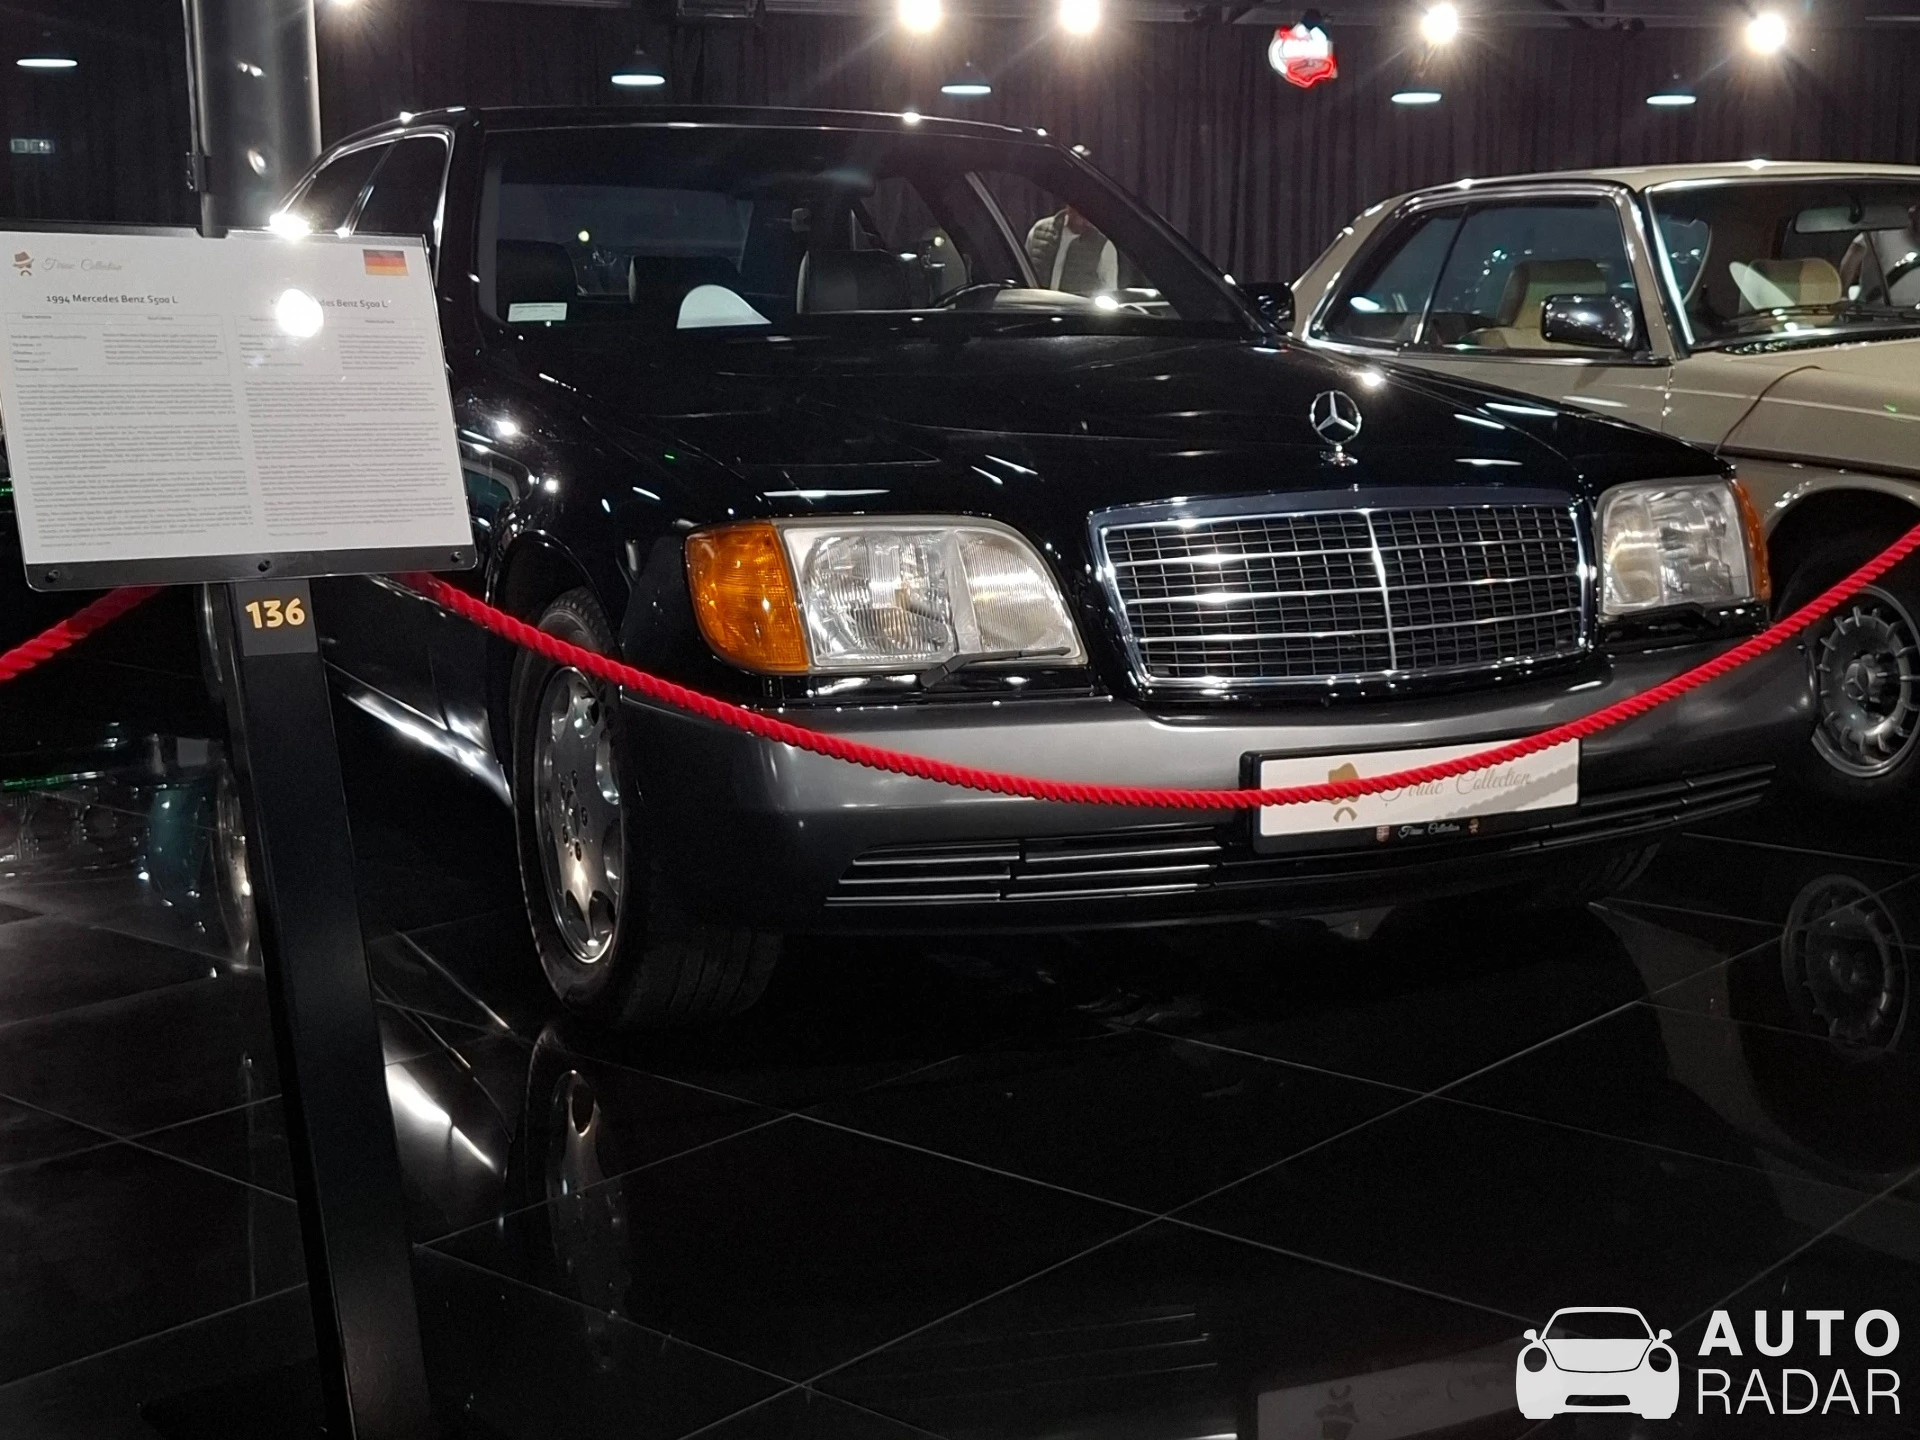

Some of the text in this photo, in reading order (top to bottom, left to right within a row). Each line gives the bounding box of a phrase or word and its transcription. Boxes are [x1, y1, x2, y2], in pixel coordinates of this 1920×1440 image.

[46, 294, 179, 305] 1994 Mercedes Benz S500 L
[336, 299, 358, 308] Benz
[360, 299, 380, 309] S500
[381, 300, 389, 308] L
[245, 597, 306, 629] 136
[1456, 767, 1531, 795] Collection
